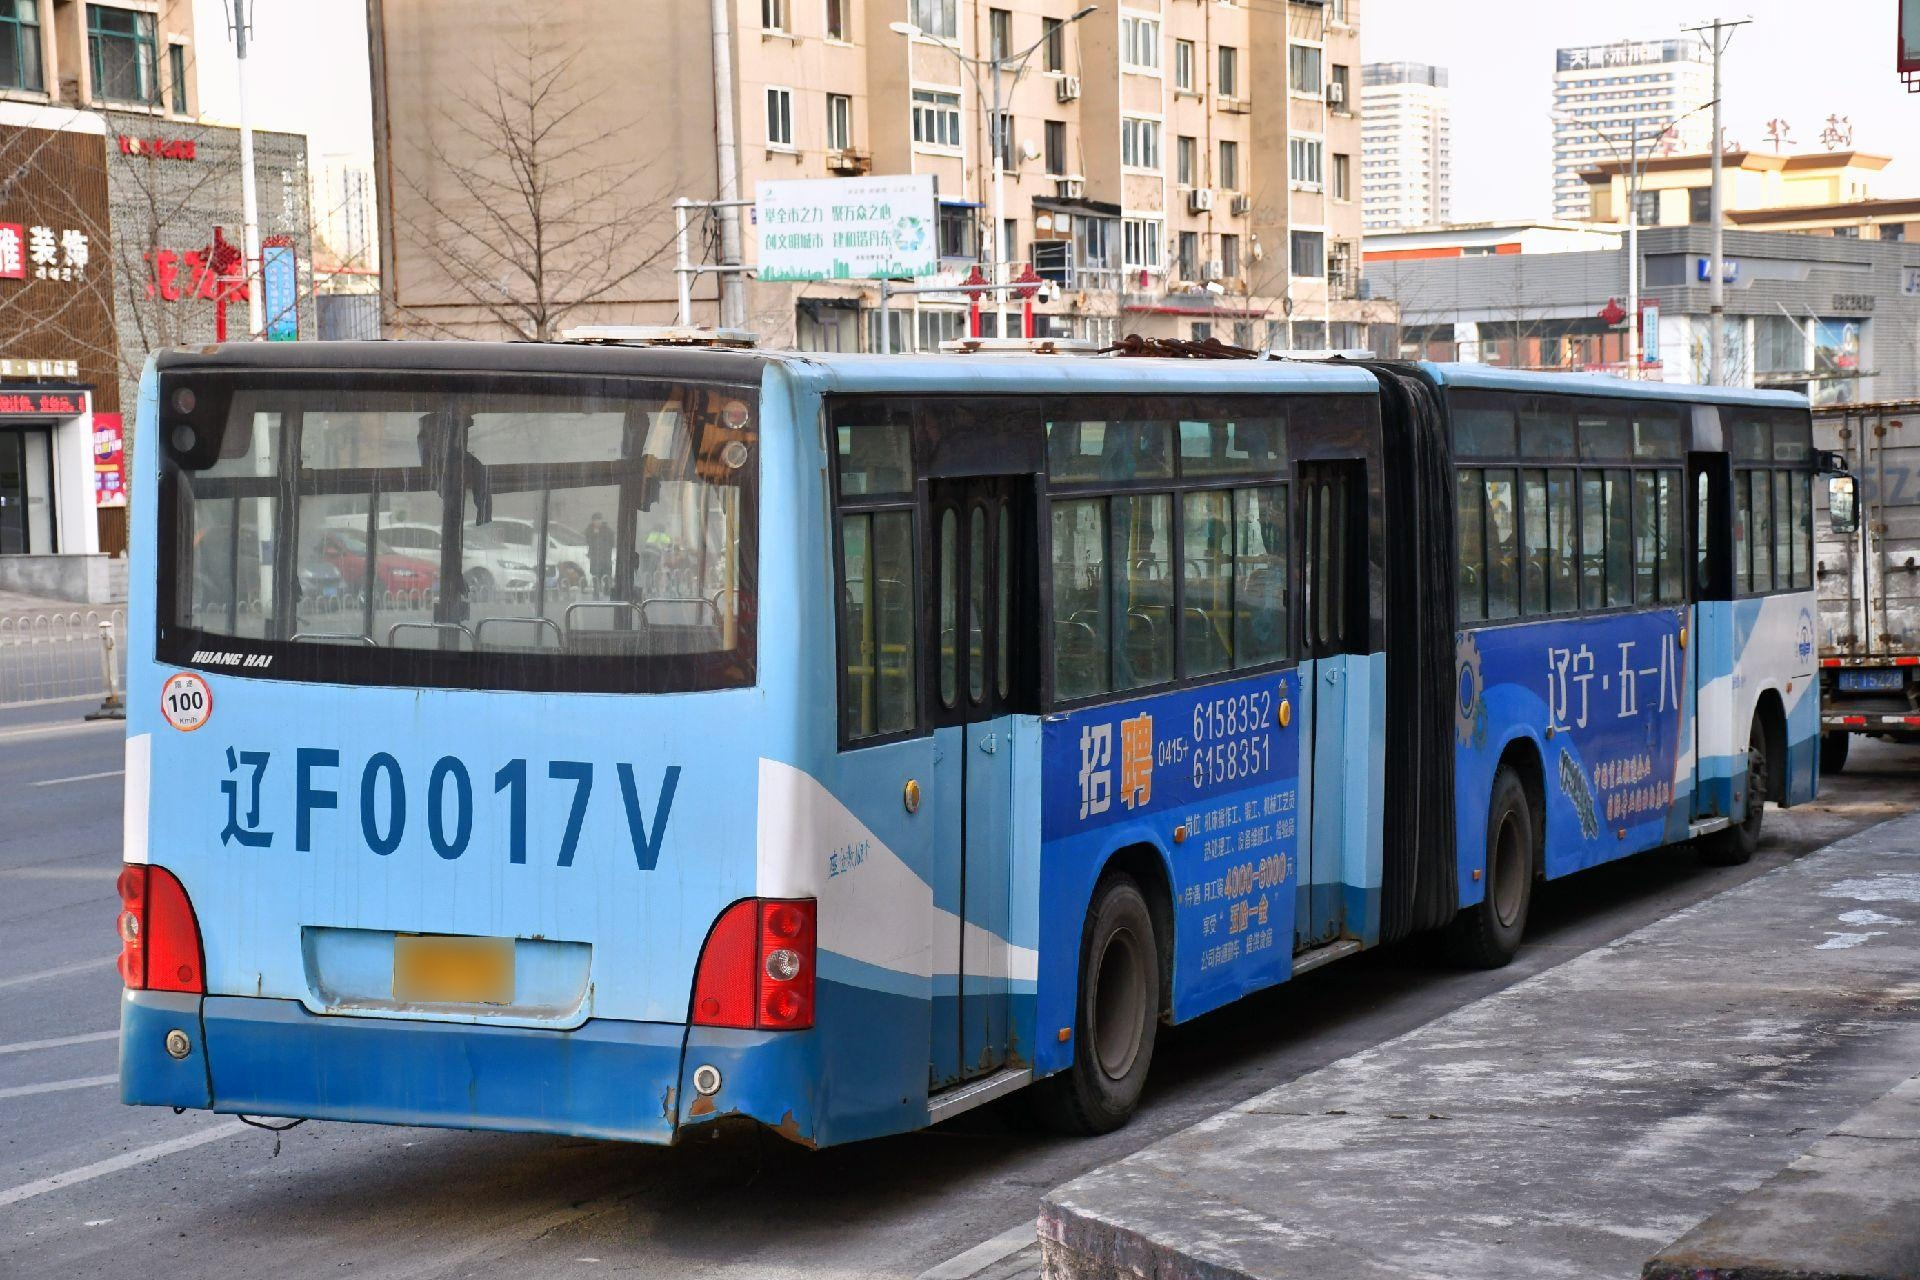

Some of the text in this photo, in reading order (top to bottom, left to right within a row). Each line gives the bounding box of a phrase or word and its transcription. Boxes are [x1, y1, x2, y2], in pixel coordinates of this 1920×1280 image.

[191, 650, 273, 668] HUANG HAI
[168, 691, 204, 713] 100
[1193, 690, 1271, 742] 6158352
[1079, 711, 1154, 820] 招聘
[1193, 733, 1270, 789] 6158351
[220, 745, 682, 870] 辽F0017V
